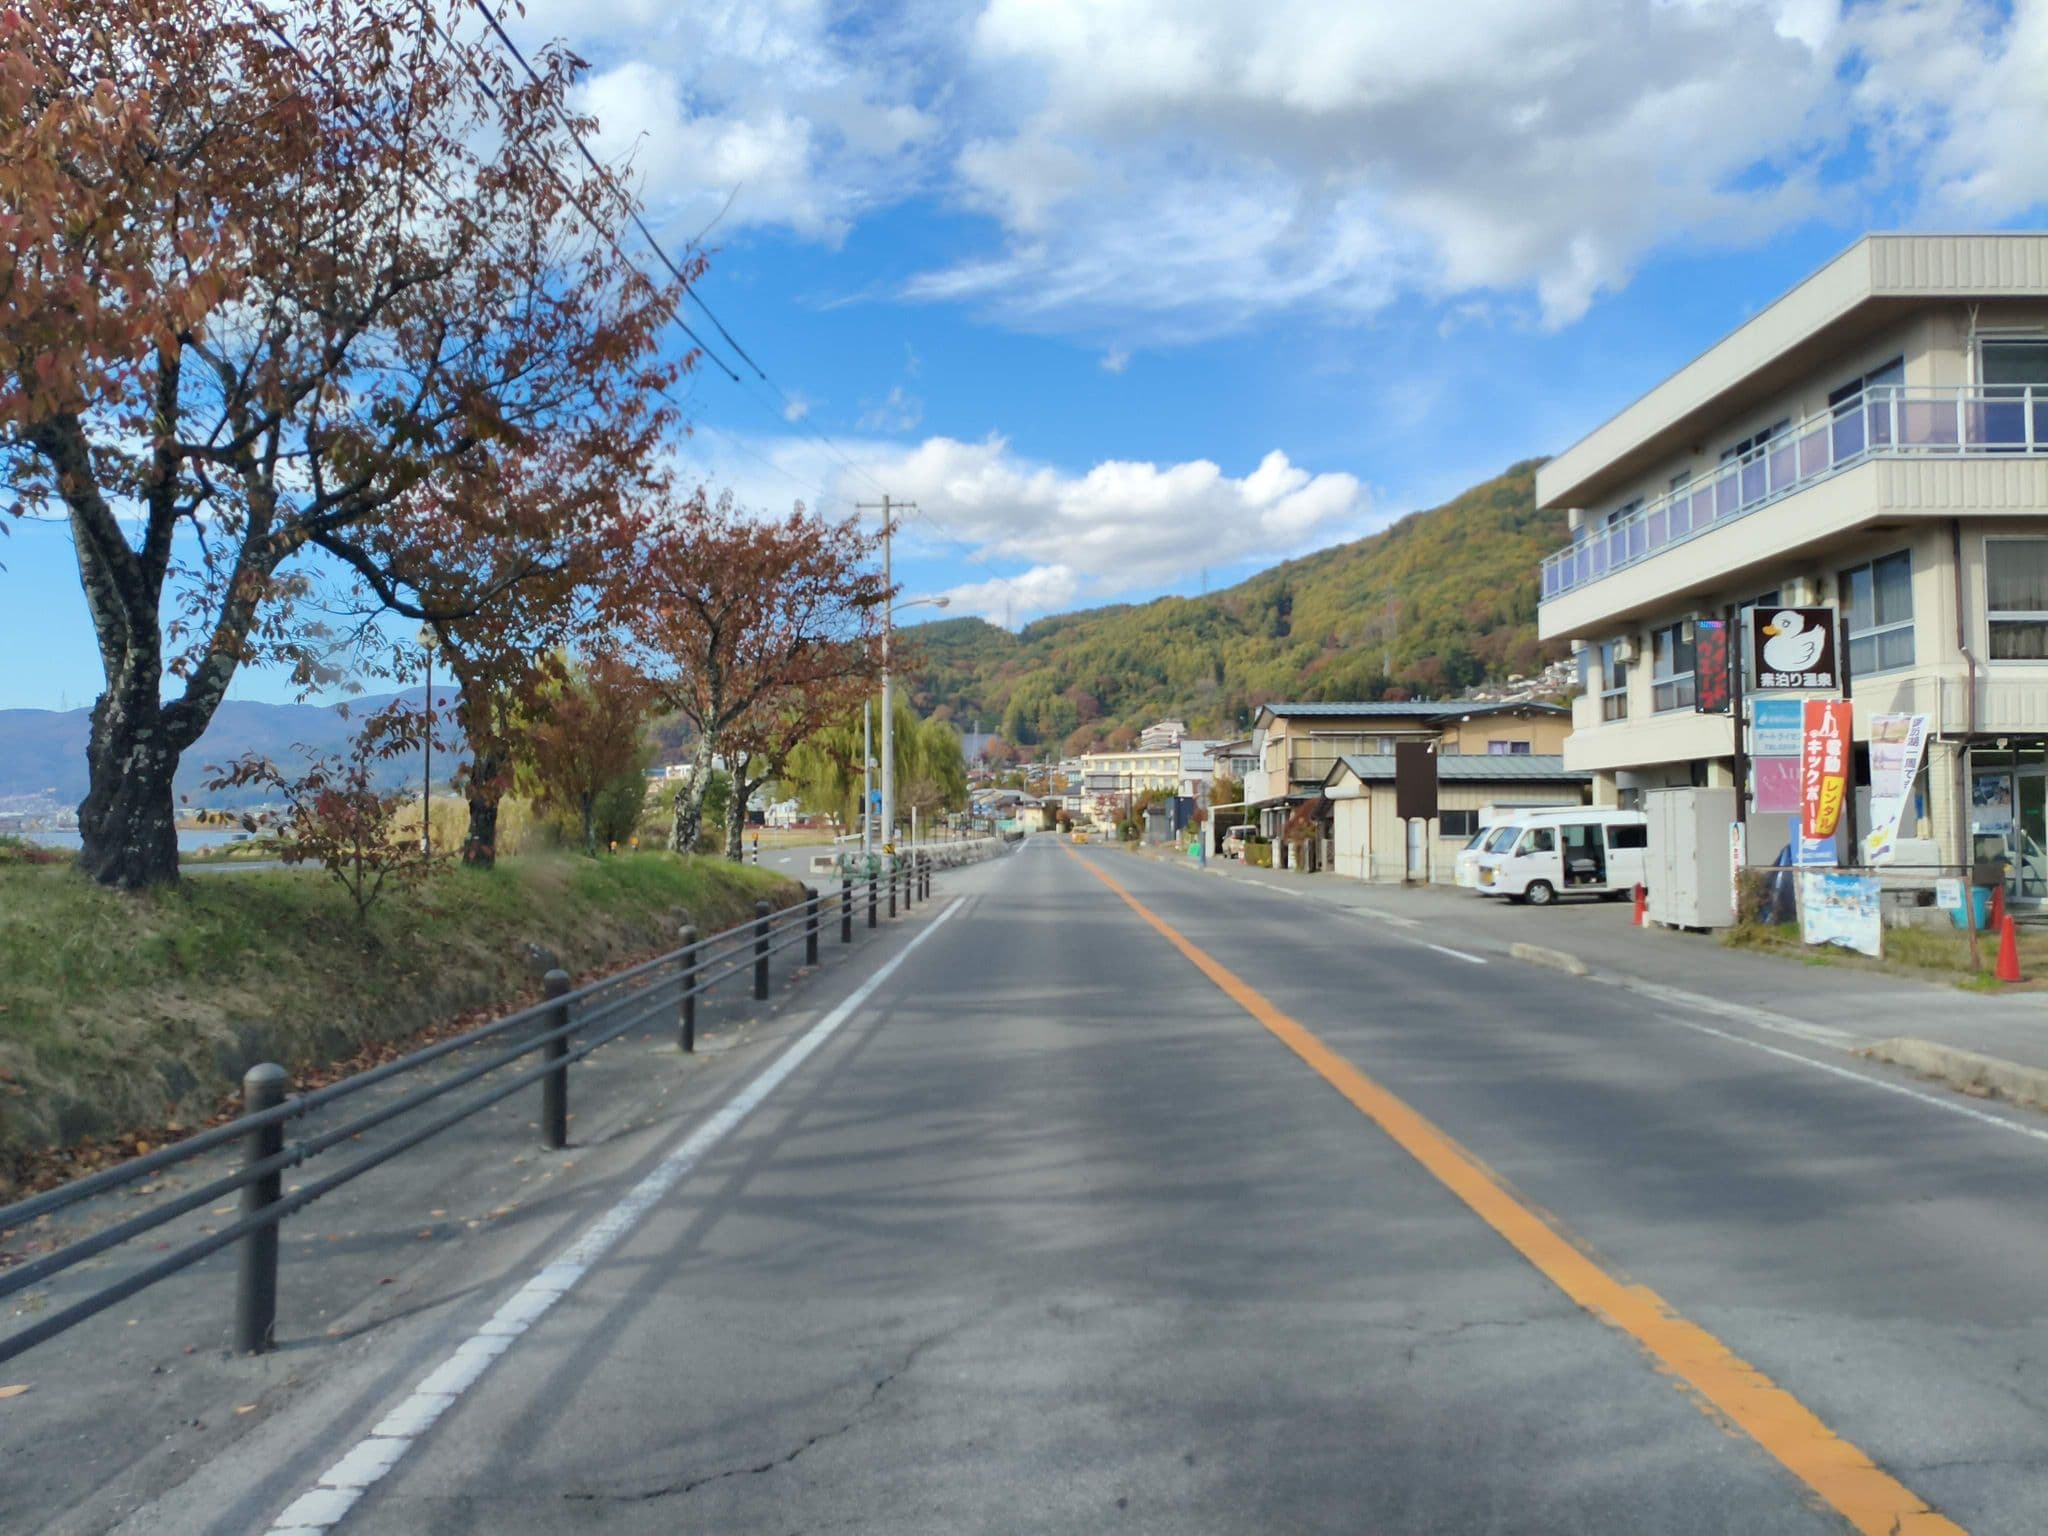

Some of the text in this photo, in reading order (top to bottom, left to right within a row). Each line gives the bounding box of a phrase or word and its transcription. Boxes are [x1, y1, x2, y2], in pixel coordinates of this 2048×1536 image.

[1760, 672, 1832, 687] 素泊り温泉
[1823, 739, 1842, 772] 電動
[1819, 781, 1838, 829] レンタル
